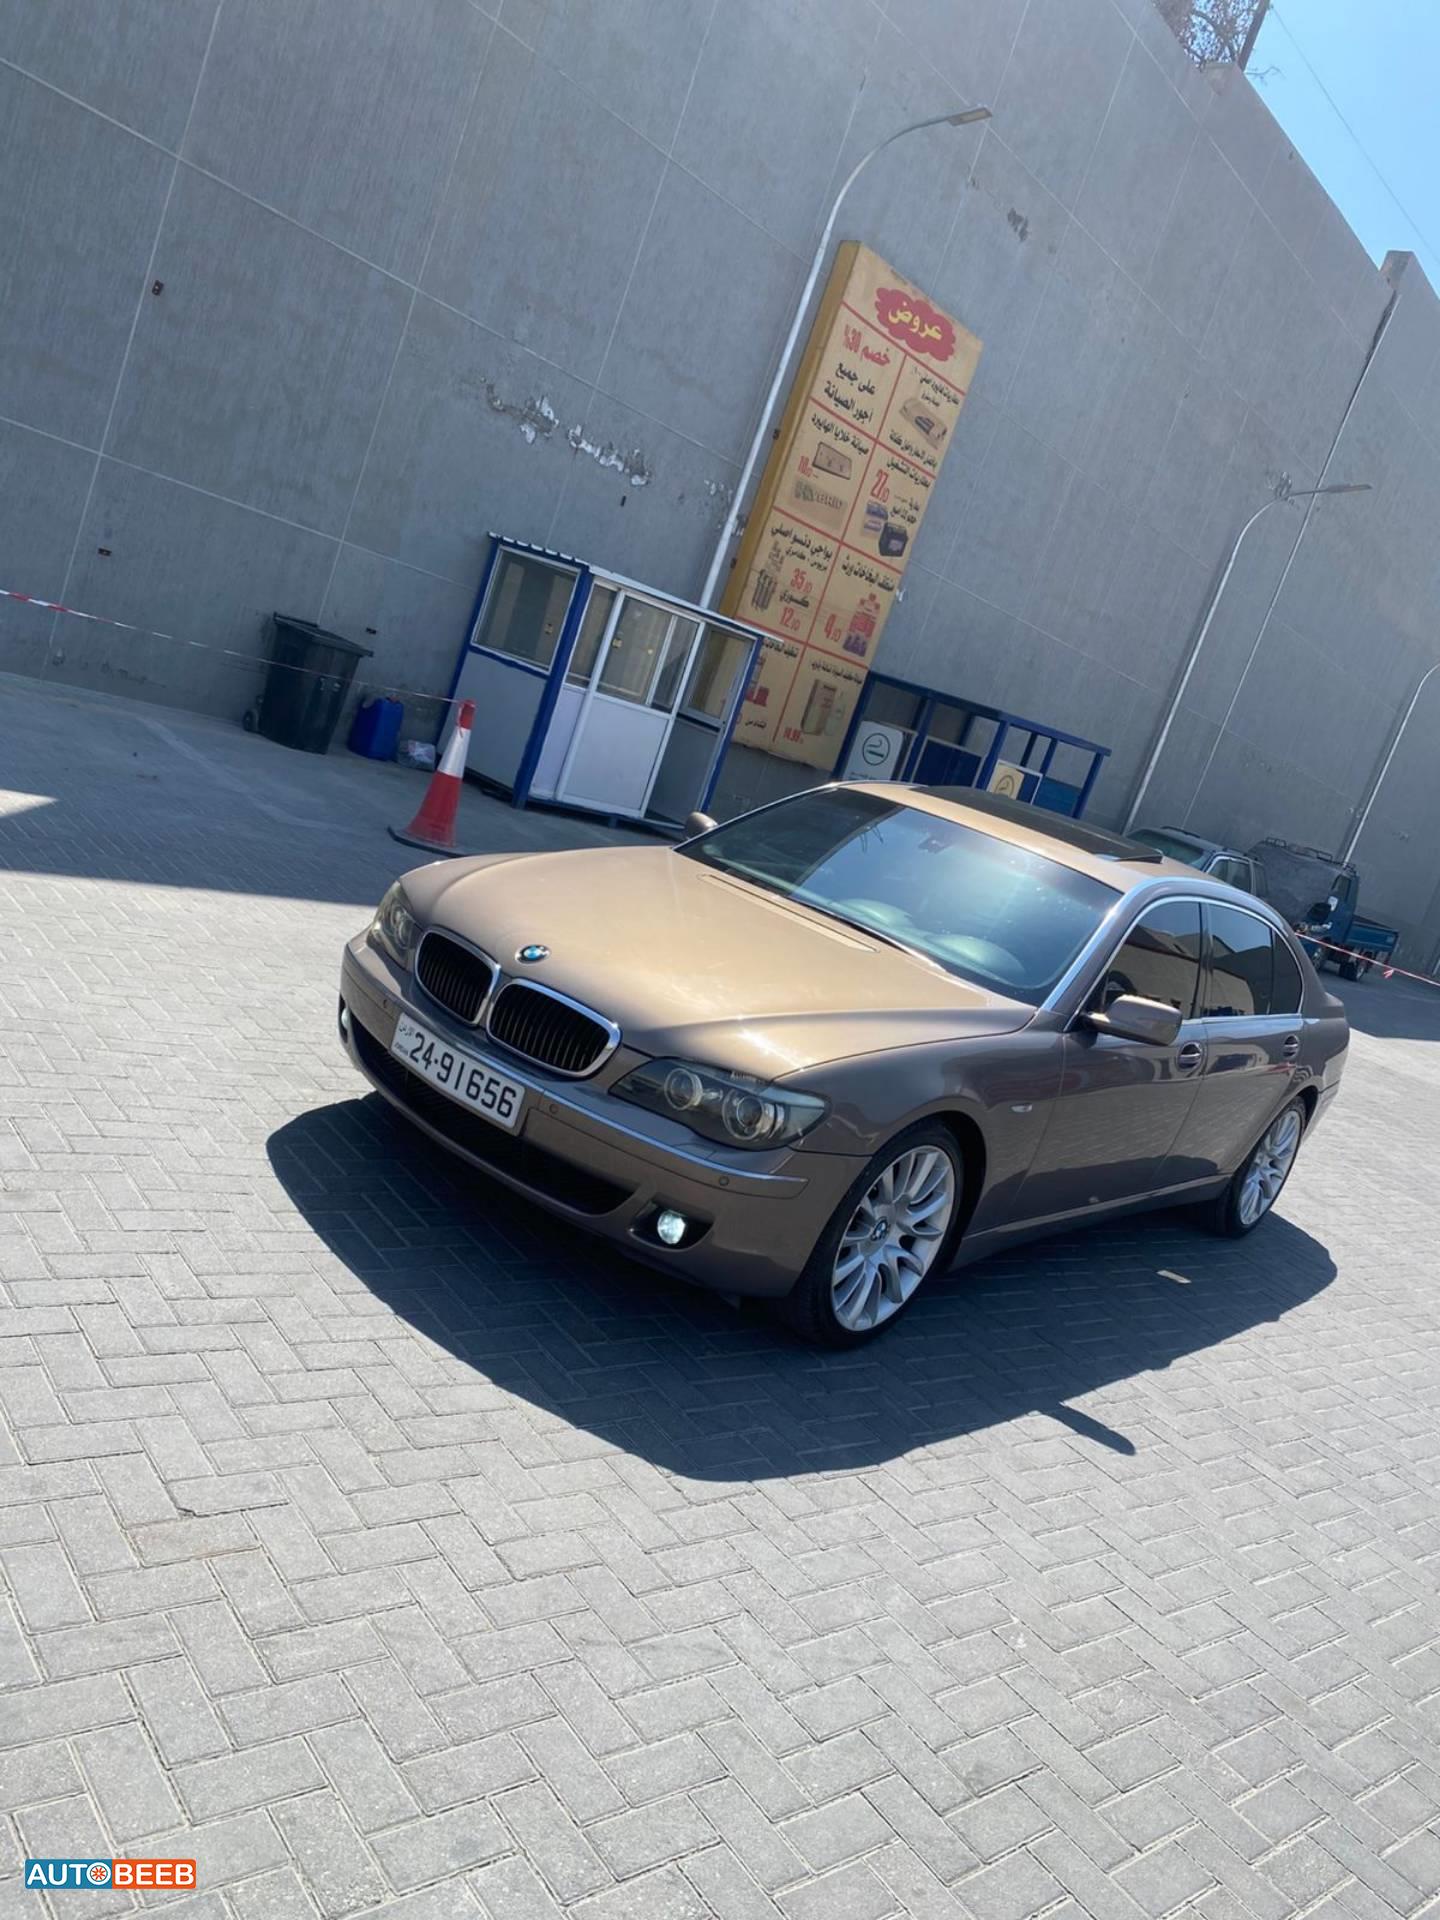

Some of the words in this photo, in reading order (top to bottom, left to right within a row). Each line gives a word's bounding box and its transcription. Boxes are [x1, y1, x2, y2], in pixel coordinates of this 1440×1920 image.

[888, 301, 942, 341] عروض
[861, 345, 890, 366] خصم
[835, 362, 858, 386] جميع
[824, 380, 856, 410] الصيانة
[858, 379, 876, 395] على
[833, 424, 850, 441] خلايا
[851, 434, 869, 455] صيانة
[886, 456, 910, 475] التشغيل
[909, 467, 931, 489] بطاريات
[771, 522, 793, 537] اصلي
[790, 533, 812, 549] دنسو
[810, 544, 833, 562] بواجي
